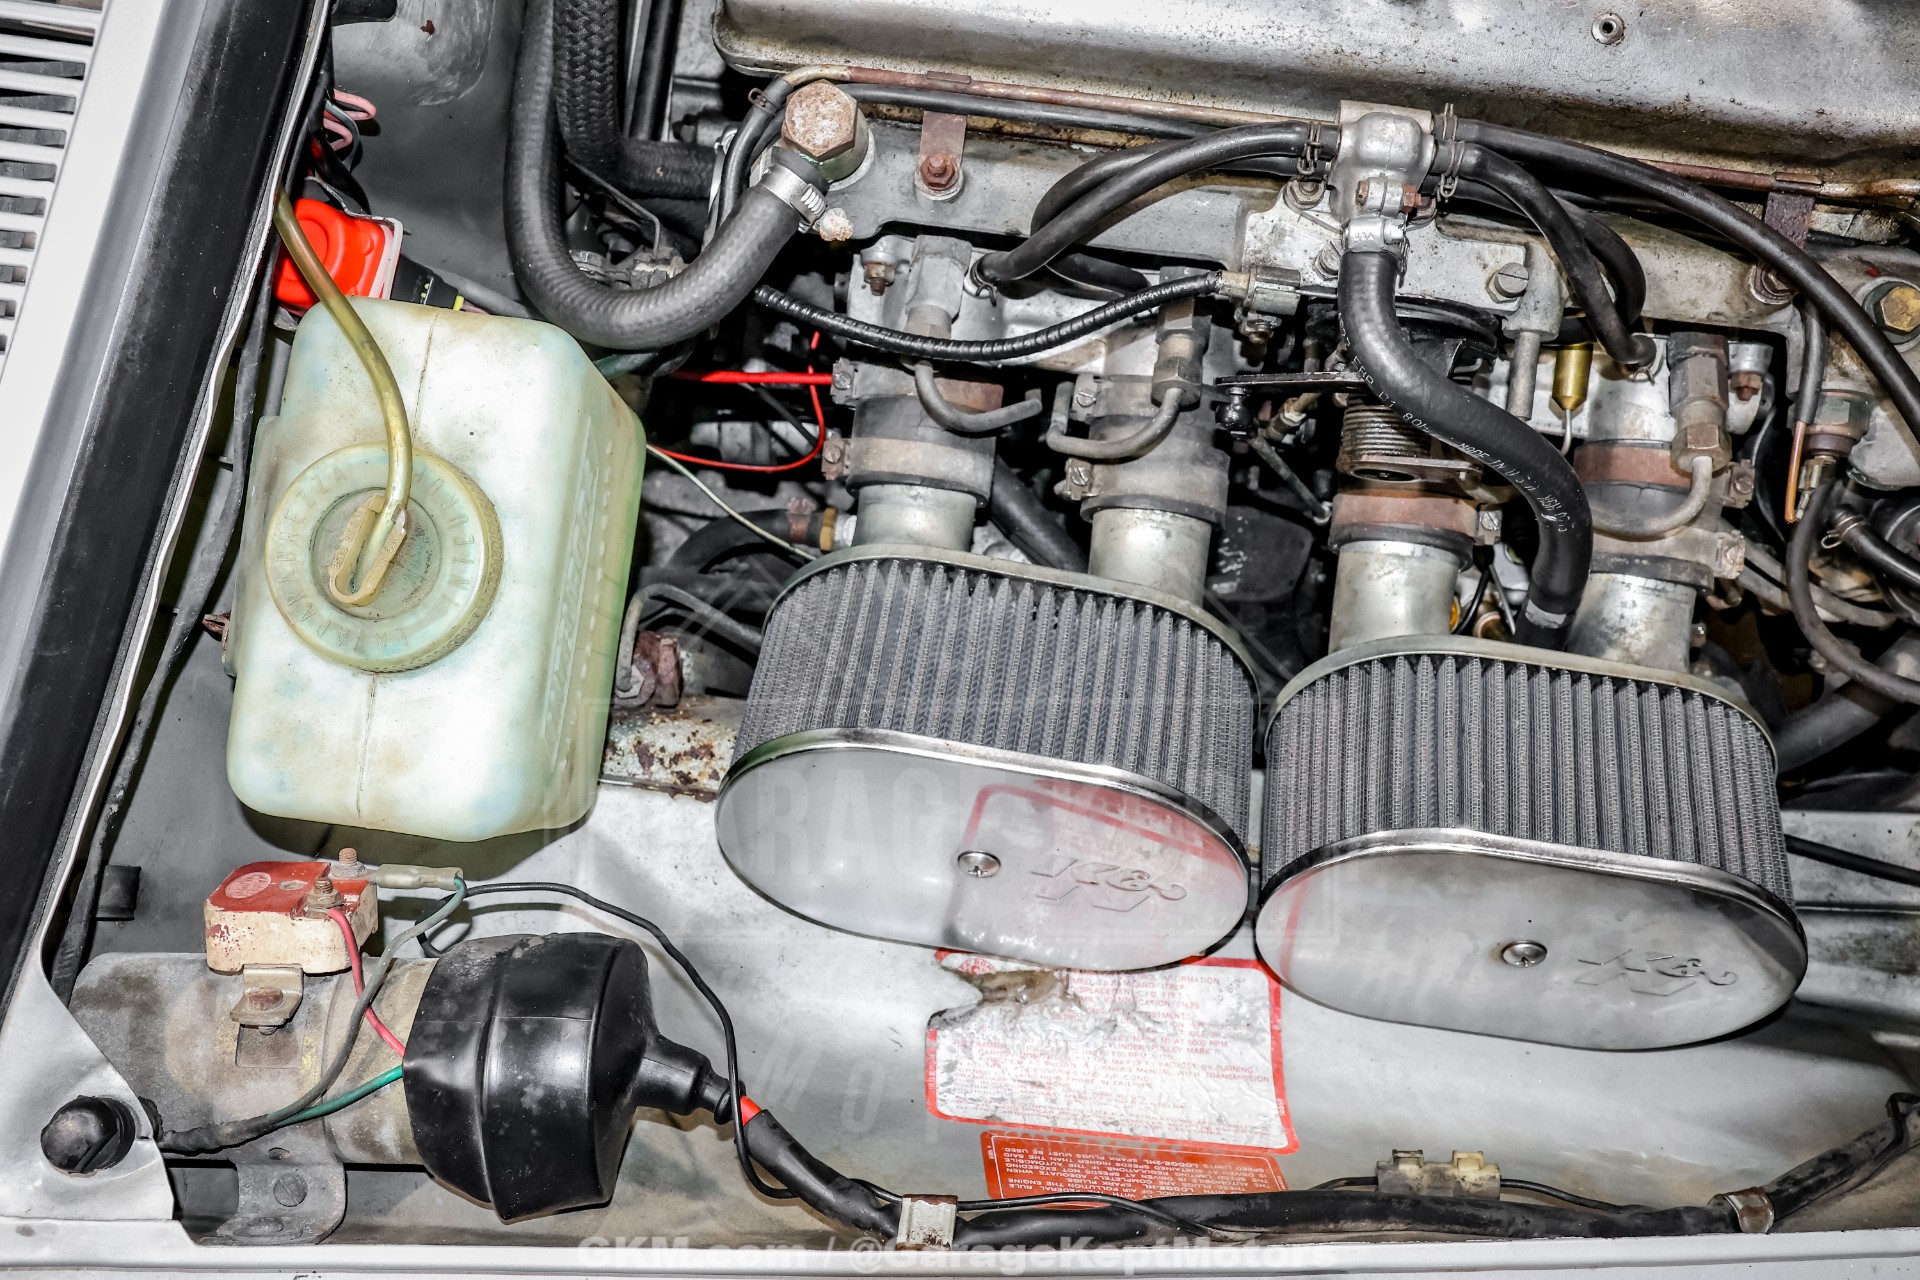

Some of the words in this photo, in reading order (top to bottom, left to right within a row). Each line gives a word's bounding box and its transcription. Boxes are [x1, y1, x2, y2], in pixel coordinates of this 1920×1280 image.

[1047, 1150, 1073, 1158] MUST
[1005, 1157, 1063, 1167] AUTOMOBILE
[1078, 1158, 1111, 1166] HIGHER
[1115, 1162, 1150, 1170] SPEEDS
[1005, 1162, 1057, 1171] EXCEEDING
[1154, 1165, 1204, 1173] SUSTAINED
[1038, 1170, 1087, 1179] ADEQUATE
[1085, 1169, 1121, 1177] SPEEDS
[1174, 1172, 1212, 1180] LIMITING
[1222, 1170, 1255, 1178] DRIVEN
[1007, 1177, 1042, 1186] ENGINE
[1093, 1175, 1153, 1184] COMPLETELY
[1140, 1173, 1174, 1182] DRIVEN
[1045, 1180, 1064, 1188] THE
[1101, 1180, 1132, 1188] SPARK
[1193, 1178, 1249, 1187] AUTOMOBILE
[1067, 1182, 1119, 1192] POLLUTION
[1142, 1183, 1195, 1193] LODGE-HL
